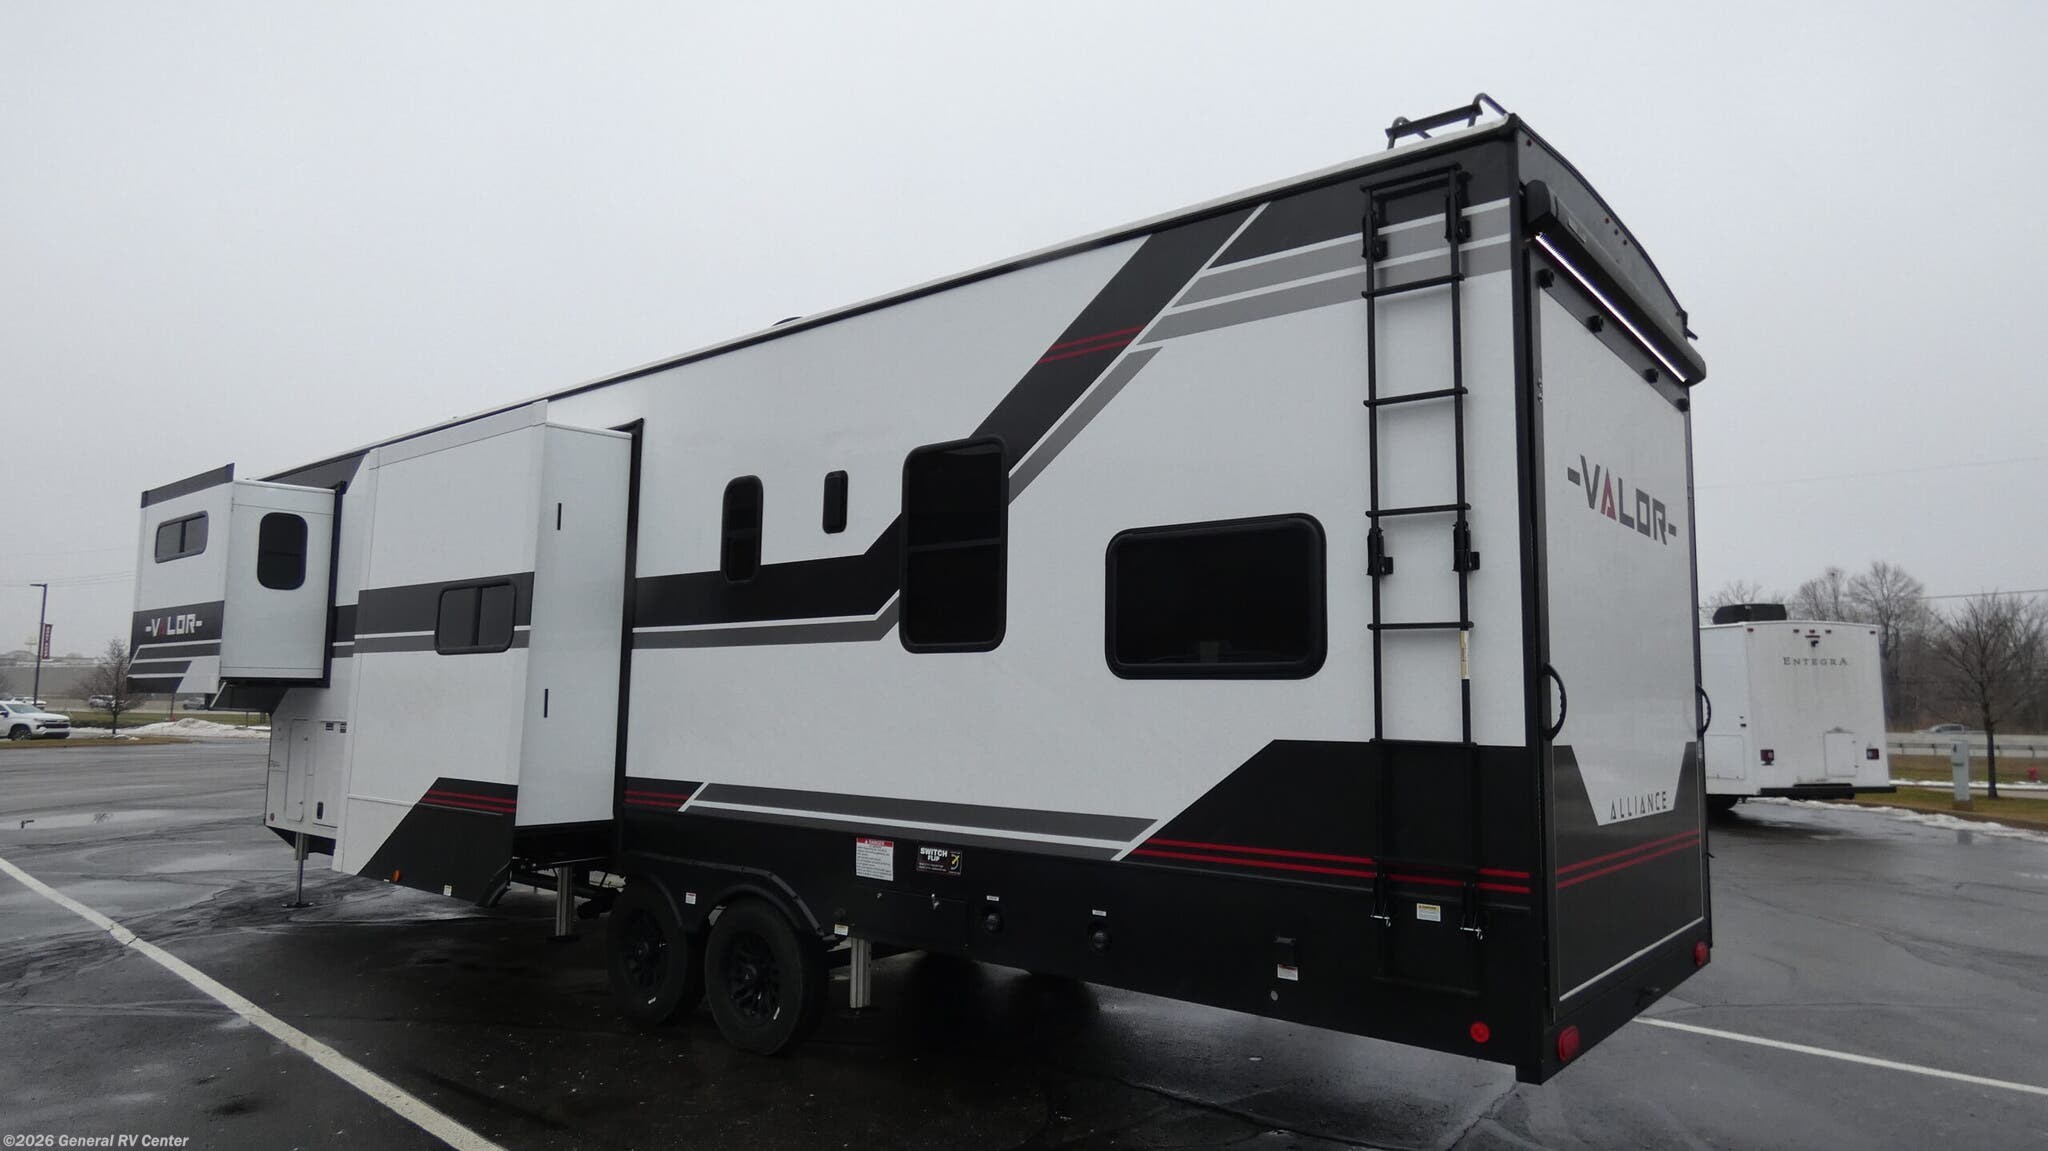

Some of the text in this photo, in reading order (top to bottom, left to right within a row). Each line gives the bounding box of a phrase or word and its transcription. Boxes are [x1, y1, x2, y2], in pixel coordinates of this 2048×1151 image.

[1783, 656, 1848, 667] ENTEGRA
[1610, 790, 1667, 820] ALLIANCE
[920, 847, 948, 858] SWITCH
